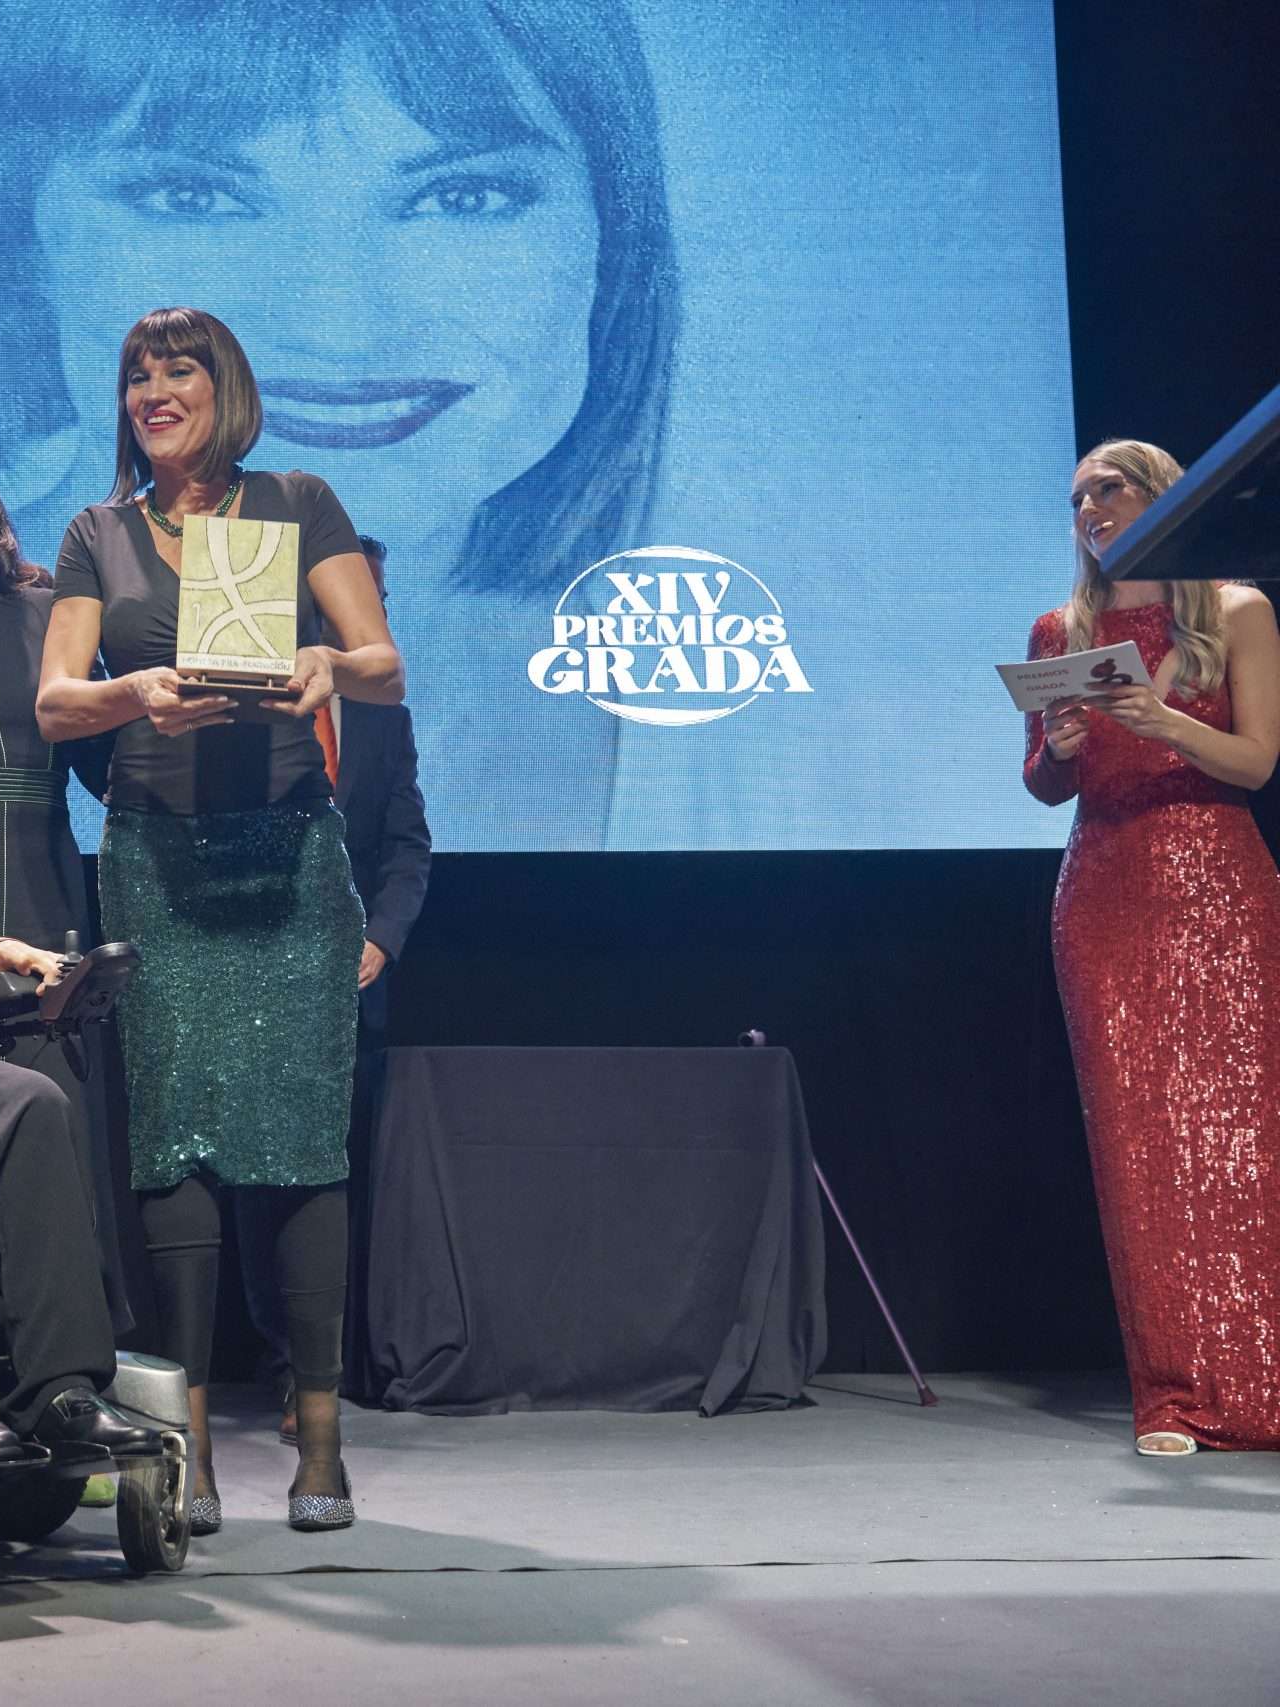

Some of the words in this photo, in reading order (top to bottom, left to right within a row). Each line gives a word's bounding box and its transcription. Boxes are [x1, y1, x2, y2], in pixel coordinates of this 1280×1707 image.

[606, 571, 730, 614] XIV
[553, 613, 787, 646] PREMIOS
[527, 645, 814, 694] GRADA
